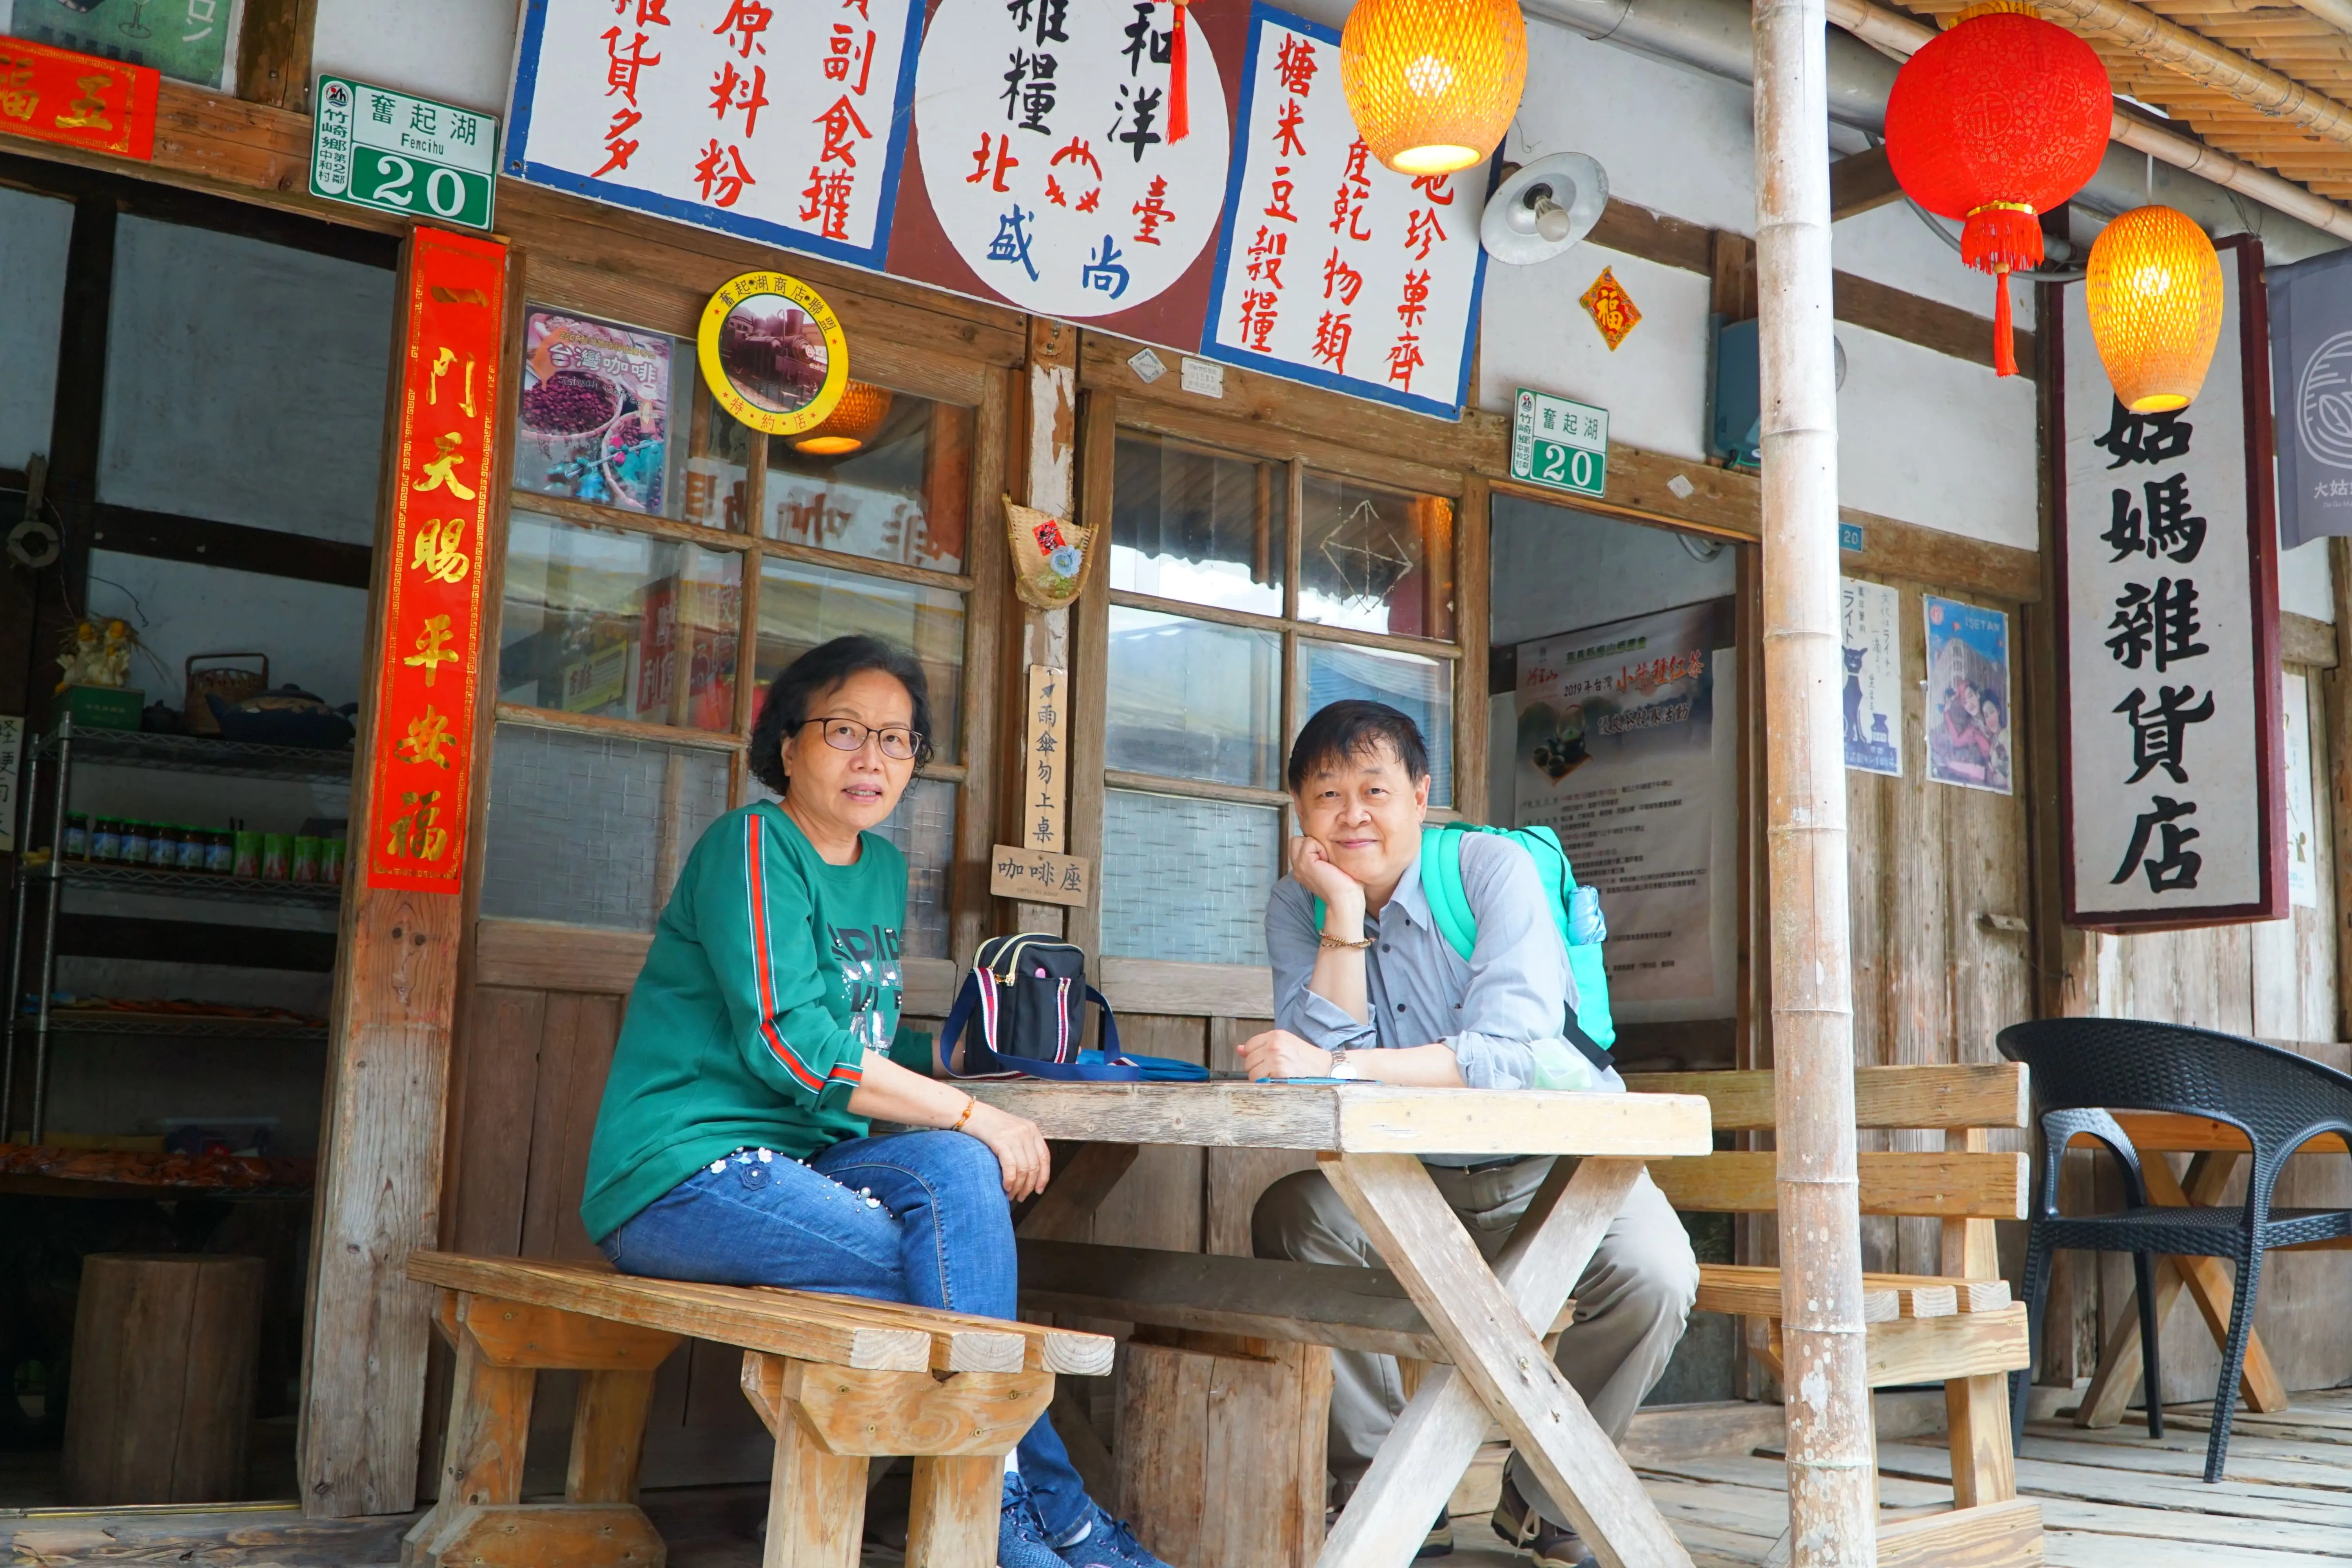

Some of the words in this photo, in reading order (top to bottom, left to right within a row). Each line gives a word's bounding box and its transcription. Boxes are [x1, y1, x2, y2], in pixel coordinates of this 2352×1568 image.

[321, 109, 349, 151] 竹崎鄉
[371, 94, 476, 146] 奮起湖
[799, 0, 876, 240] 副食罐
[318, 149, 332, 182] 中和村
[373, 156, 465, 217] 20
[719, 275, 837, 334] 奮起湖商店聯盟
[1596, 289, 1624, 332] 福
[549, 343, 658, 383] 台灣咖啡
[1543, 408, 1598, 440] 奮起湖
[1543, 445, 1592, 486] 20
[2313, 479, 2352, 499] 大姑
[1844, 530, 1858, 544] 20
[387, 285, 489, 862] 一門天賜平安福
[2094, 392, 2214, 894] 姑媽雜貨店
[1032, 704, 1058, 842] 雨傘勿上桌
[998, 857, 1082, 893] 咖啡座
